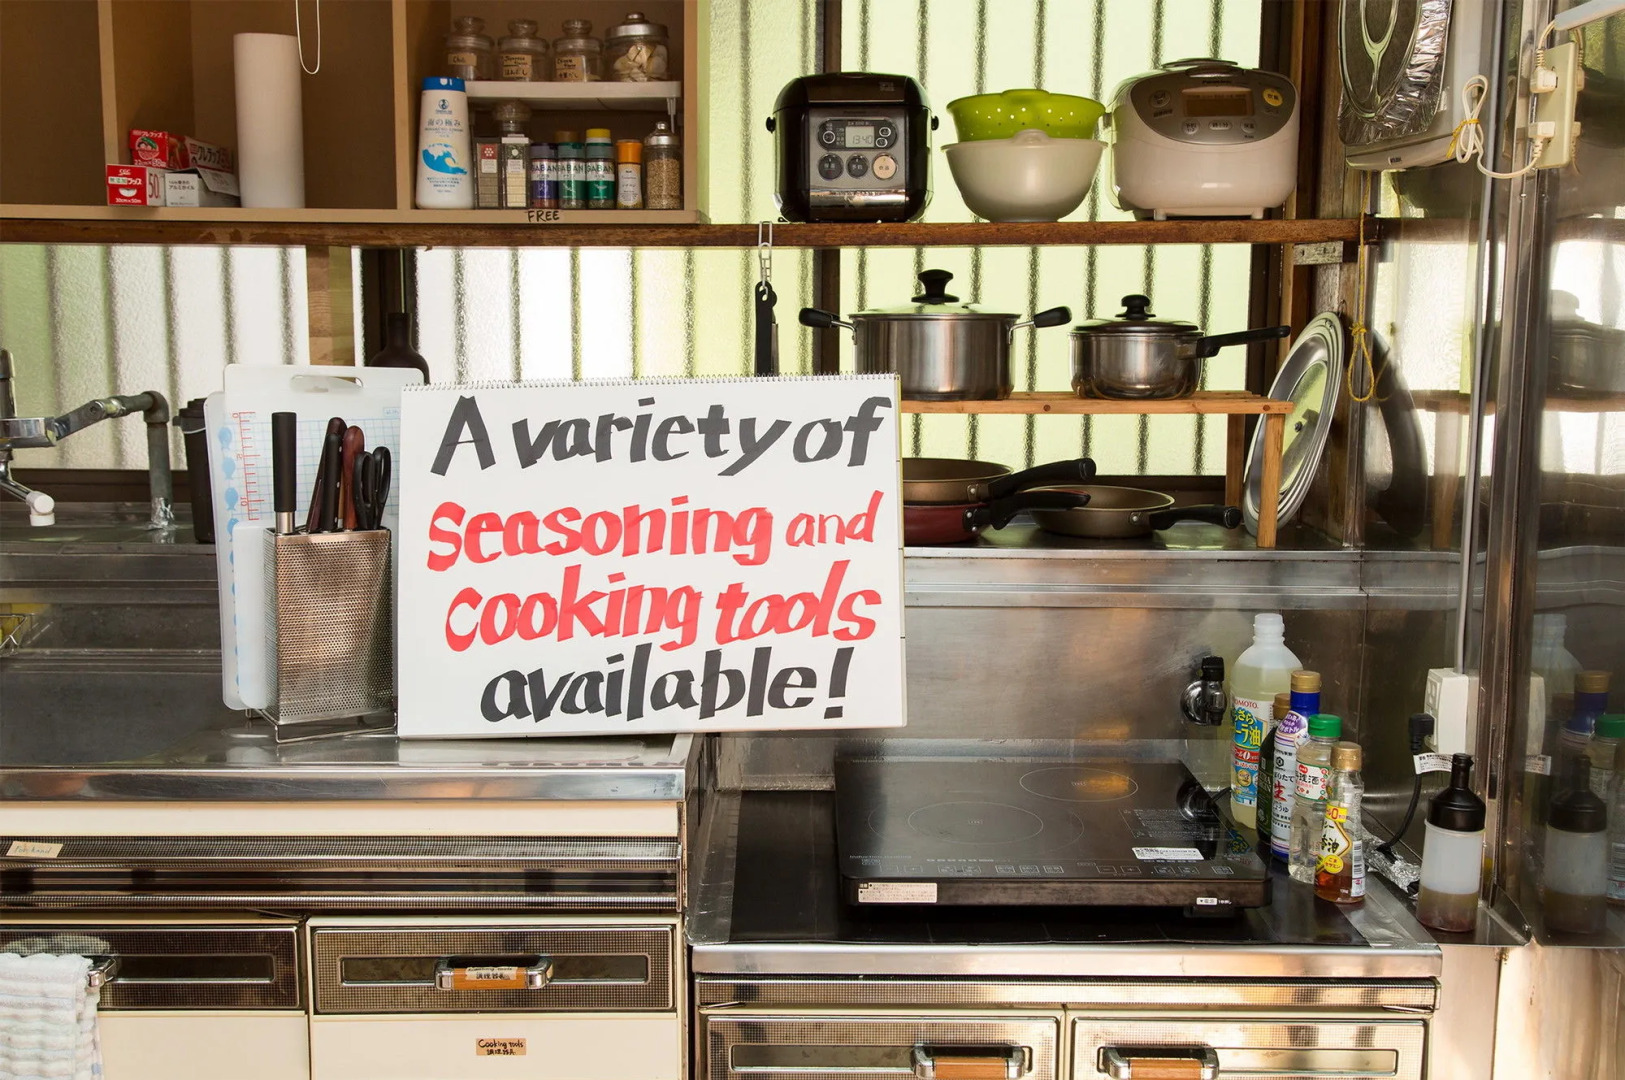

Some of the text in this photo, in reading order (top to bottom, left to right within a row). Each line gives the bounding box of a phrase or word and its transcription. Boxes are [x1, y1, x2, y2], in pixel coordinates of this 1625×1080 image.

[528, 210, 560, 222] FREE
[430, 395, 892, 476] A variety of
[427, 490, 885, 572] Seasoning and
[715, 559, 882, 645] tools
[480, 642, 855, 724] available!
[478, 1039, 508, 1050] Cooking
